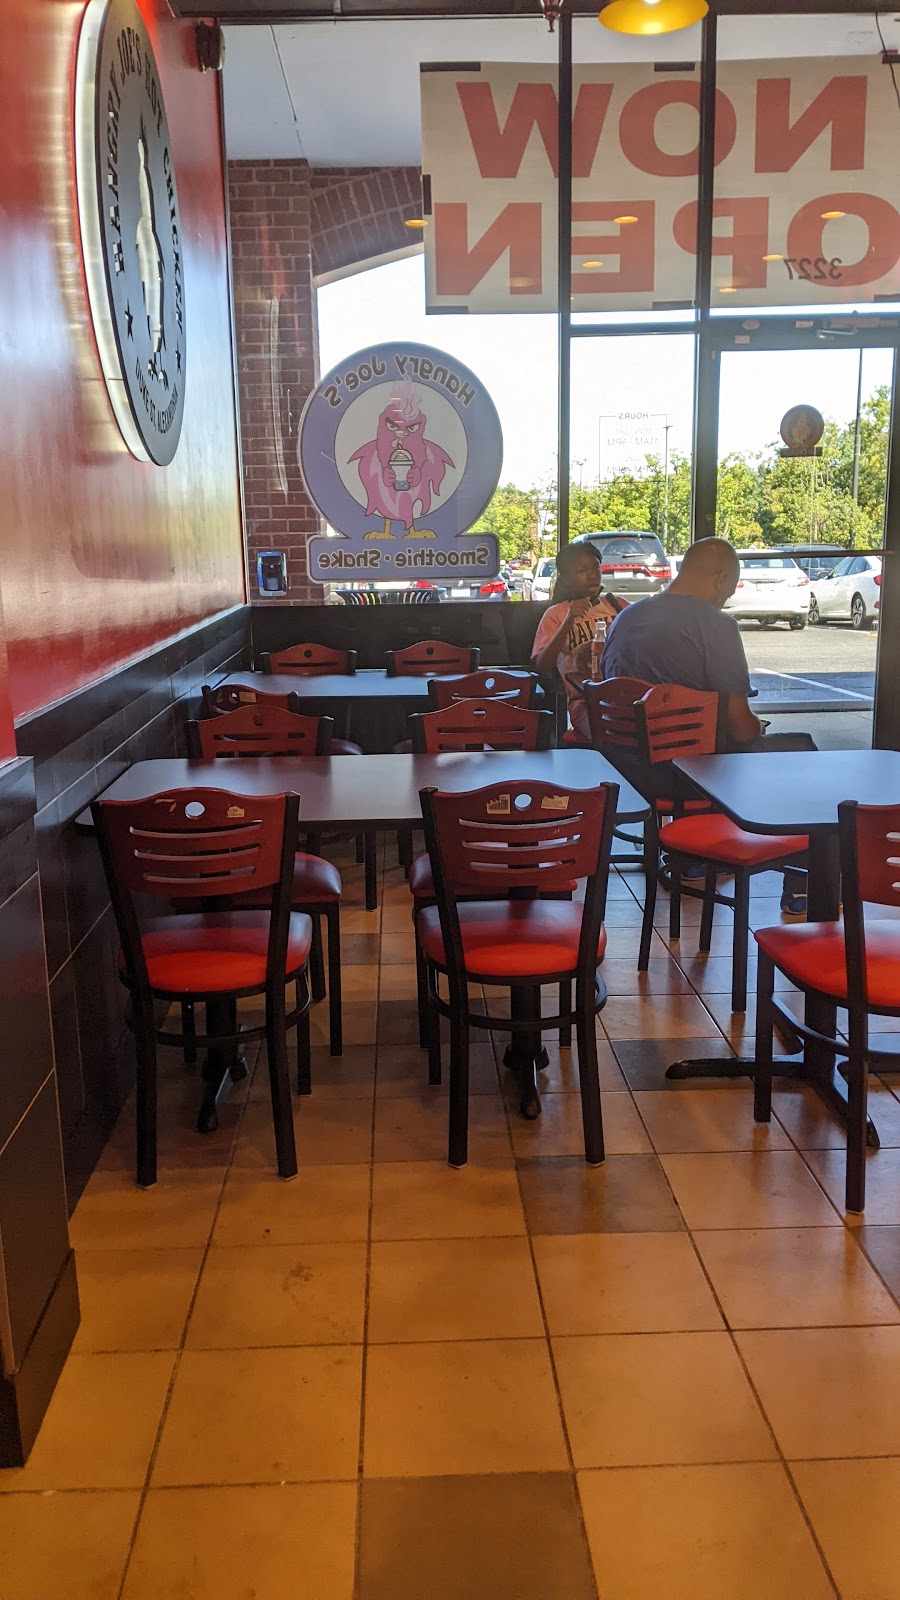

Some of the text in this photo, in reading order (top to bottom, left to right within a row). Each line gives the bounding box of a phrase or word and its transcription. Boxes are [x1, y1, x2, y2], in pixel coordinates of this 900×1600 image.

[107, 27, 183, 335] HANGRY JOE'S HOT CHICKEN
[135, 356, 149, 413] DUKE
